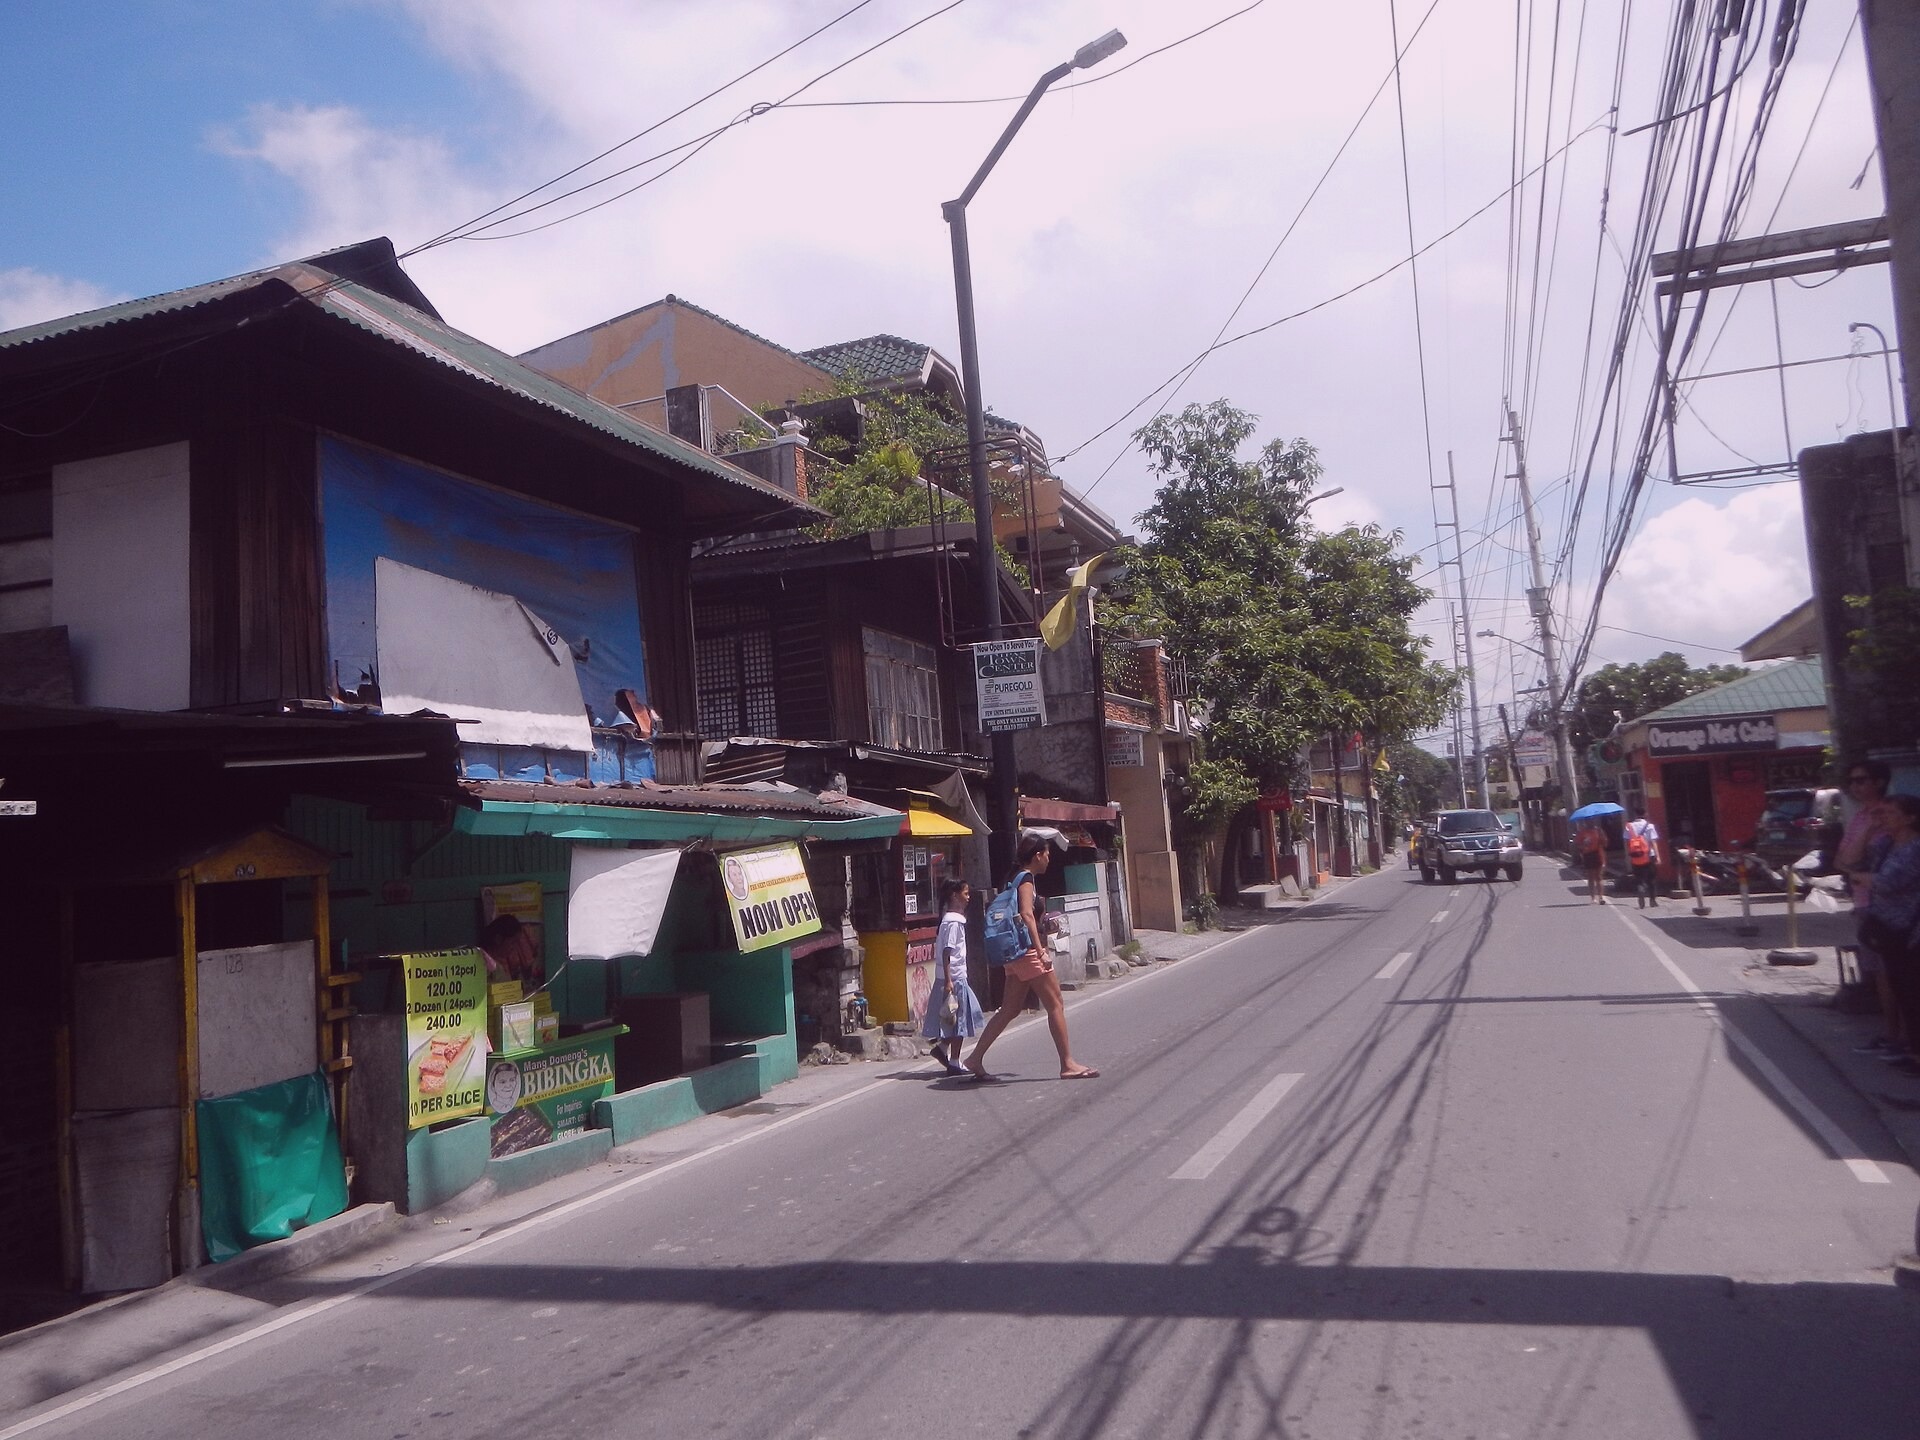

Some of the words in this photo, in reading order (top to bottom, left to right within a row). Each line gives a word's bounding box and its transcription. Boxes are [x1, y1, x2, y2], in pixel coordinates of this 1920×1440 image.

[990, 643, 1003, 652] Open
[979, 662, 1034, 678] CENTER
[995, 681, 1033, 693] PUREGOLD
[1649, 727, 1706, 751] Orange
[1706, 722, 1738, 745] Net
[1738, 720, 1775, 743] Cafe
[738, 899, 784, 939] NOW
[780, 891, 820, 926] OPEN
[908, 943, 933, 964] PINOY
[407, 968, 412, 979] 1
[415, 967, 443, 979] Dozen
[427, 981, 462, 997] 120.00
[407, 1003, 411, 1014] 2
[414, 1001, 442, 1013] Dozen
[426, 1013, 462, 1031] 240.00
[523, 1060, 547, 1072] Mang
[549, 1048, 588, 1066] Domeng's
[523, 1052, 613, 1097] BIBINGKA
[421, 1096, 443, 1114] PER
[446, 1089, 480, 1108] SLICE
[557, 1116, 577, 1128] SMART:
[557, 1128, 577, 1141] GLOBE:
